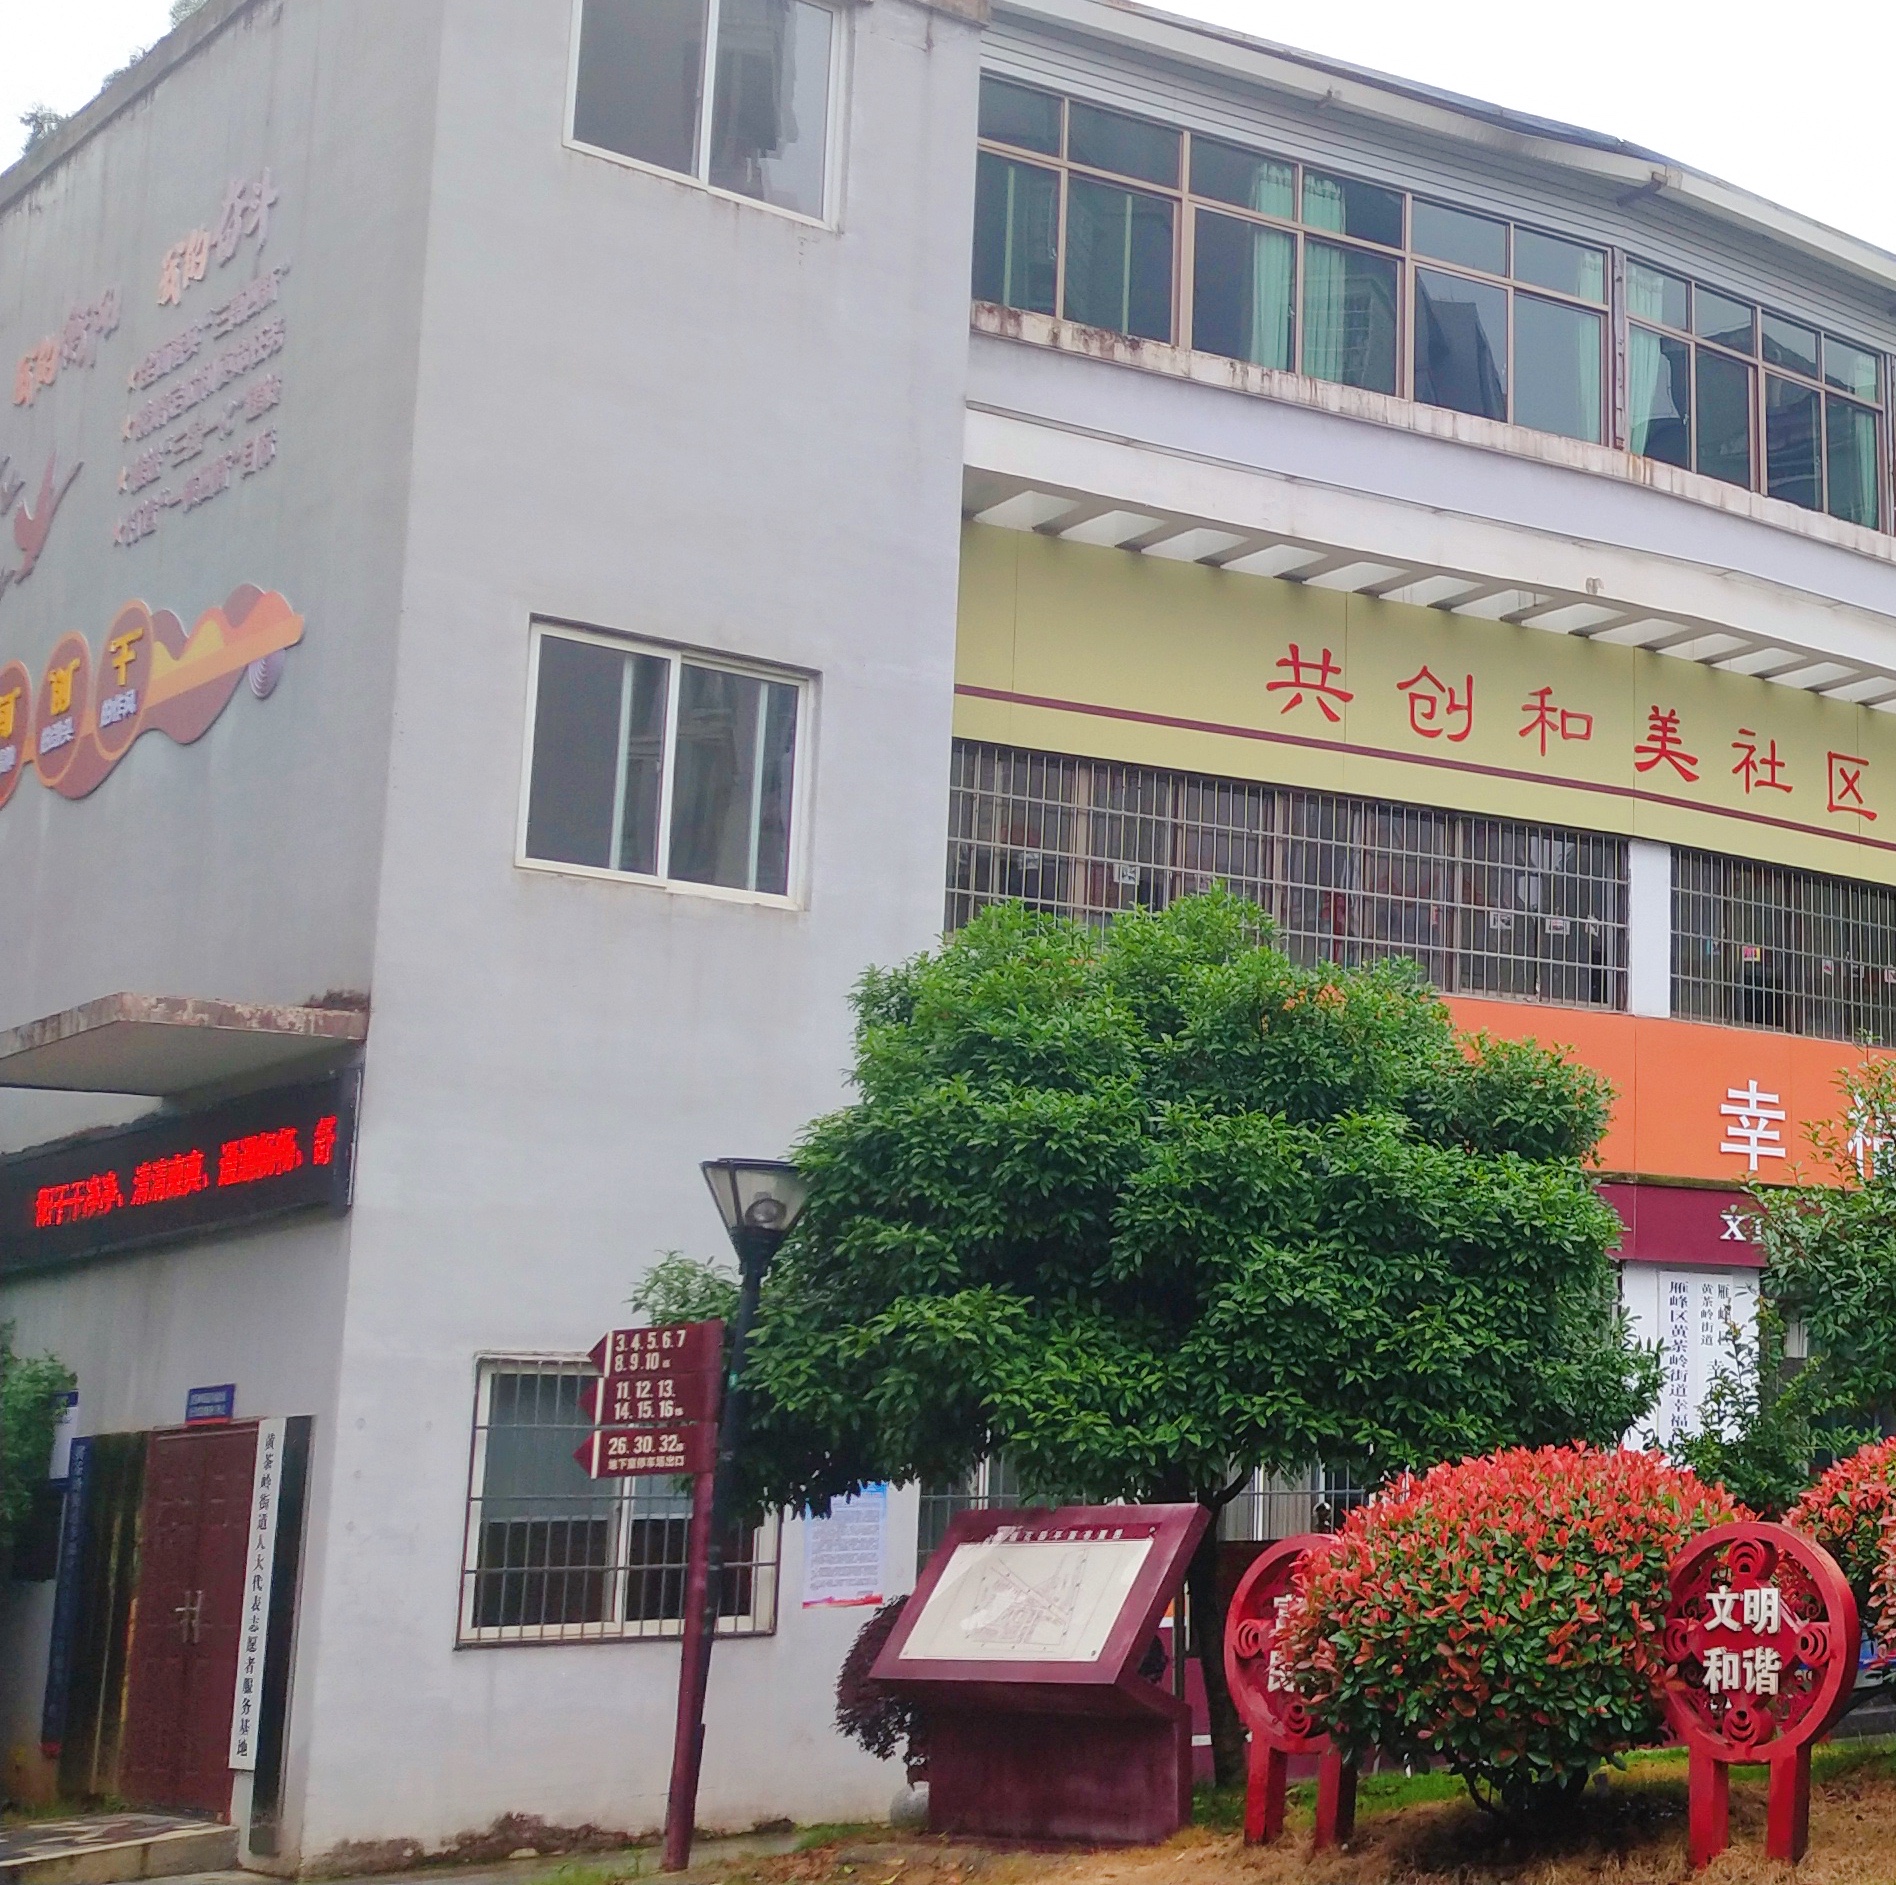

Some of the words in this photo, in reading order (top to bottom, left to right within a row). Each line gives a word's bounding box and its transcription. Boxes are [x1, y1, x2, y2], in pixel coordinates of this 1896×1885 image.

[1265, 643, 1878, 821] 共创和美社区
[1700, 1283, 1714, 1346] 黄茶岭街道
[236, 1432, 276, 1757] 黄茶岭街道人大代表志愿者服务基地
[1704, 1585, 1781, 1634] 文明
[1702, 1646, 1783, 1696] 和谐
